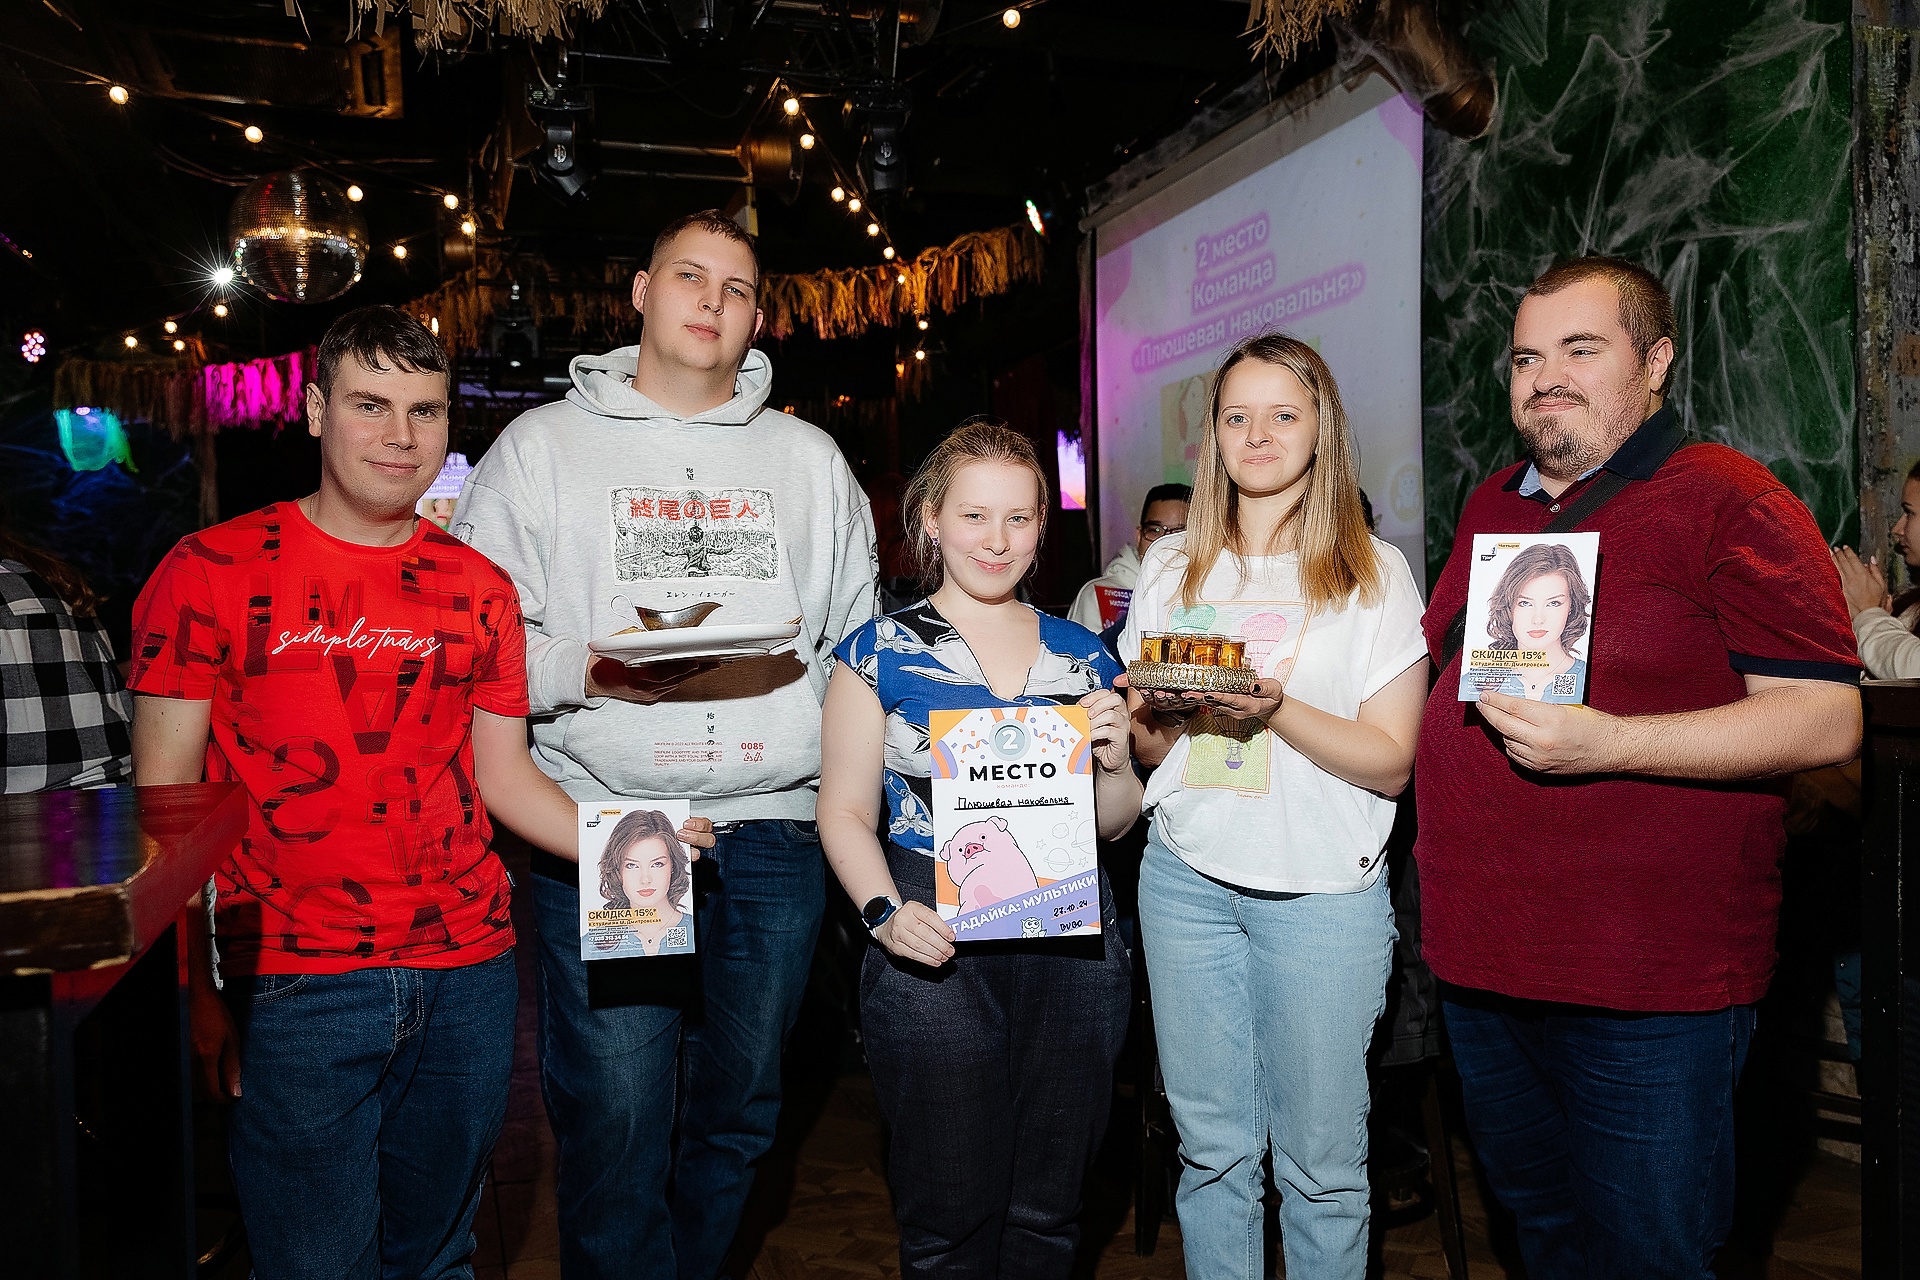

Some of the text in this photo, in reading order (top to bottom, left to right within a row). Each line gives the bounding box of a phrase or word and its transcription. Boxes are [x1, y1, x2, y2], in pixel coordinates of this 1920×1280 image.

[1199, 219, 1268, 268] 2 место
[1192, 258, 1275, 308] Команда
[1230, 269, 1363, 336] наковальня»
[1471, 650, 1518, 660] СКИДКА
[740, 742, 764, 750] 0085
[1001, 729, 1018, 750] 2
[969, 762, 1057, 782] МЕСТО
[958, 796, 1070, 809] Плюшевая наковальня
[947, 874, 1097, 934] ГАДАЙКА: МУЛЬТИКИ
[1053, 900, 1088, 917] 27.10.24
[588, 910, 632, 920] СКИДКА
